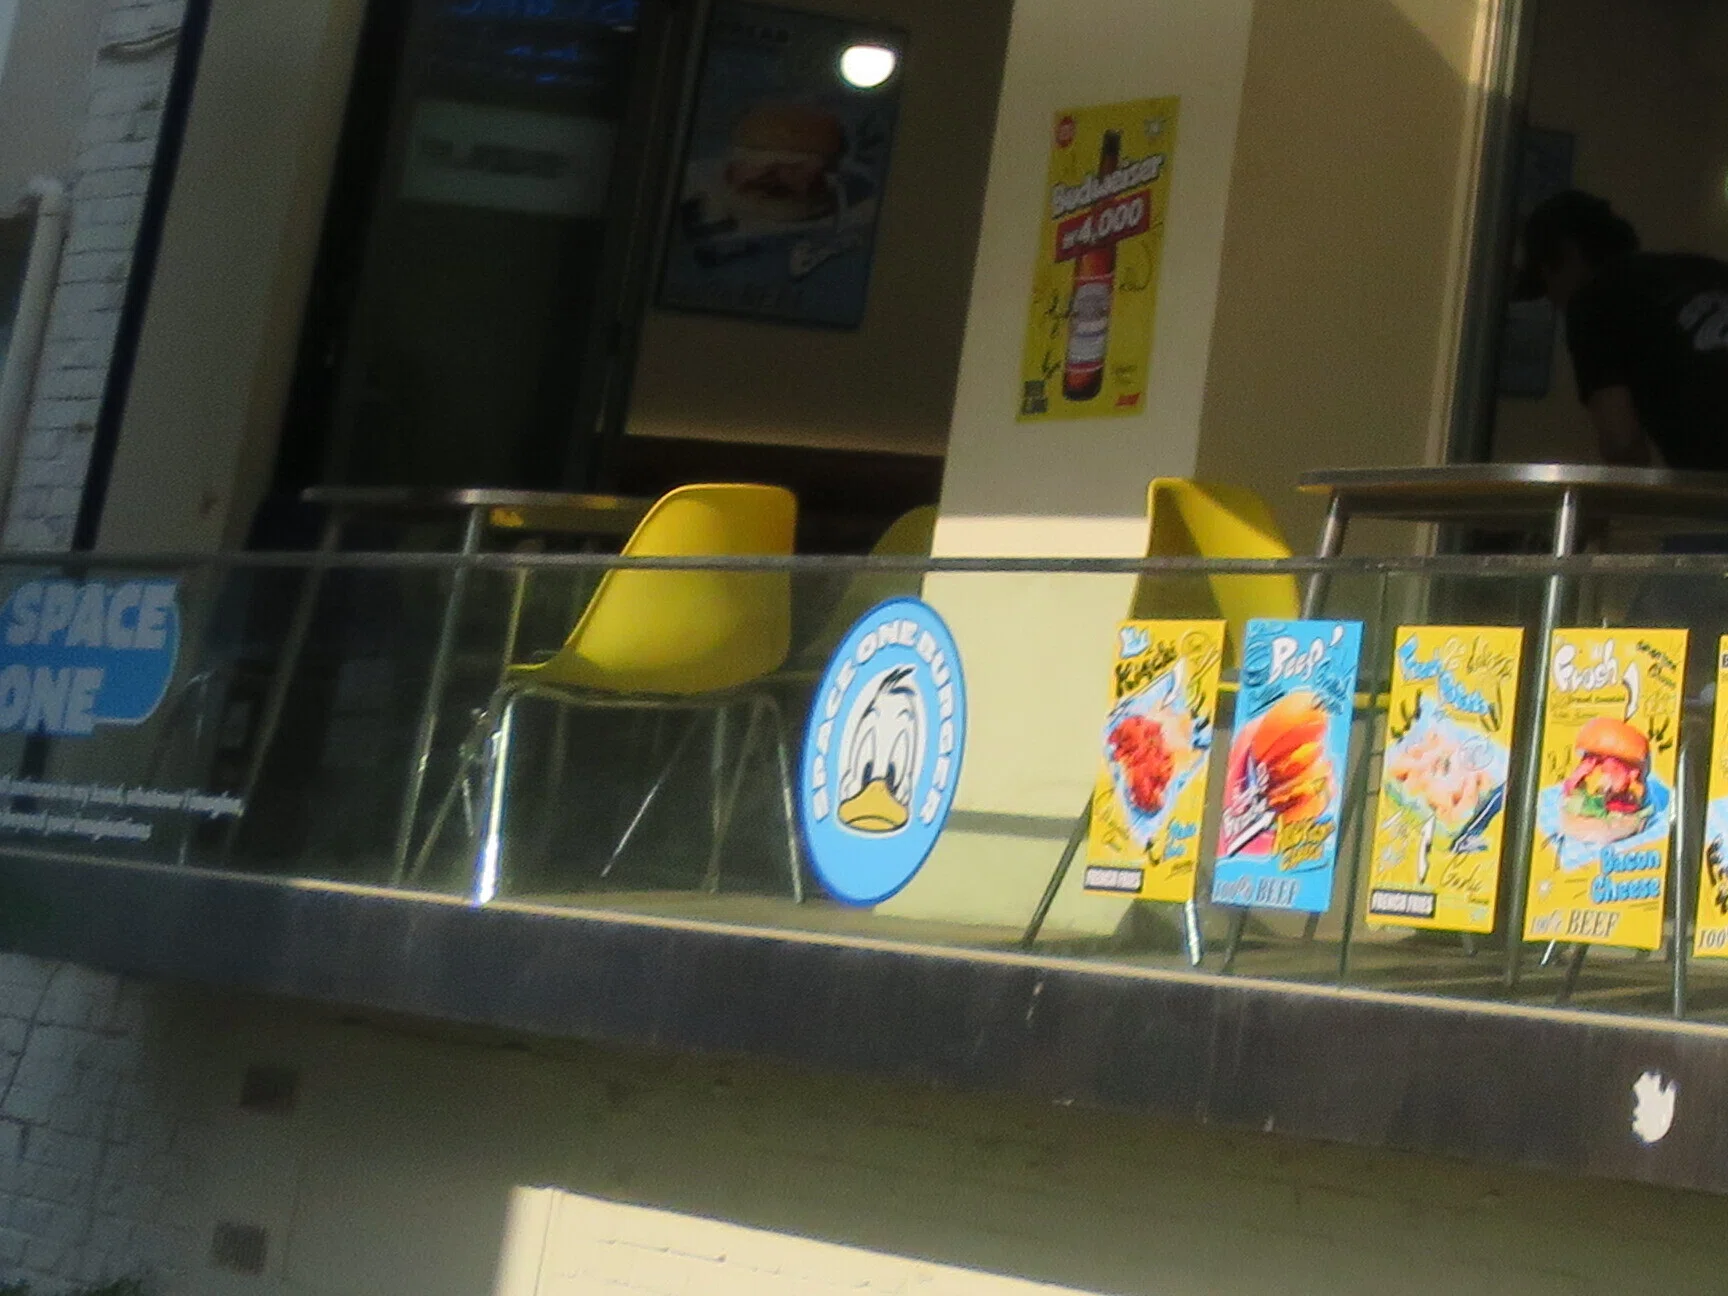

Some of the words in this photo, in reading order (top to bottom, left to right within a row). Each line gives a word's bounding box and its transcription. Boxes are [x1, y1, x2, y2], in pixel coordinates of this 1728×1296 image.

[5, 581, 181, 650] SPACE
[0, 664, 106, 737] ONE
[1566, 909, 1621, 938] BEEF
